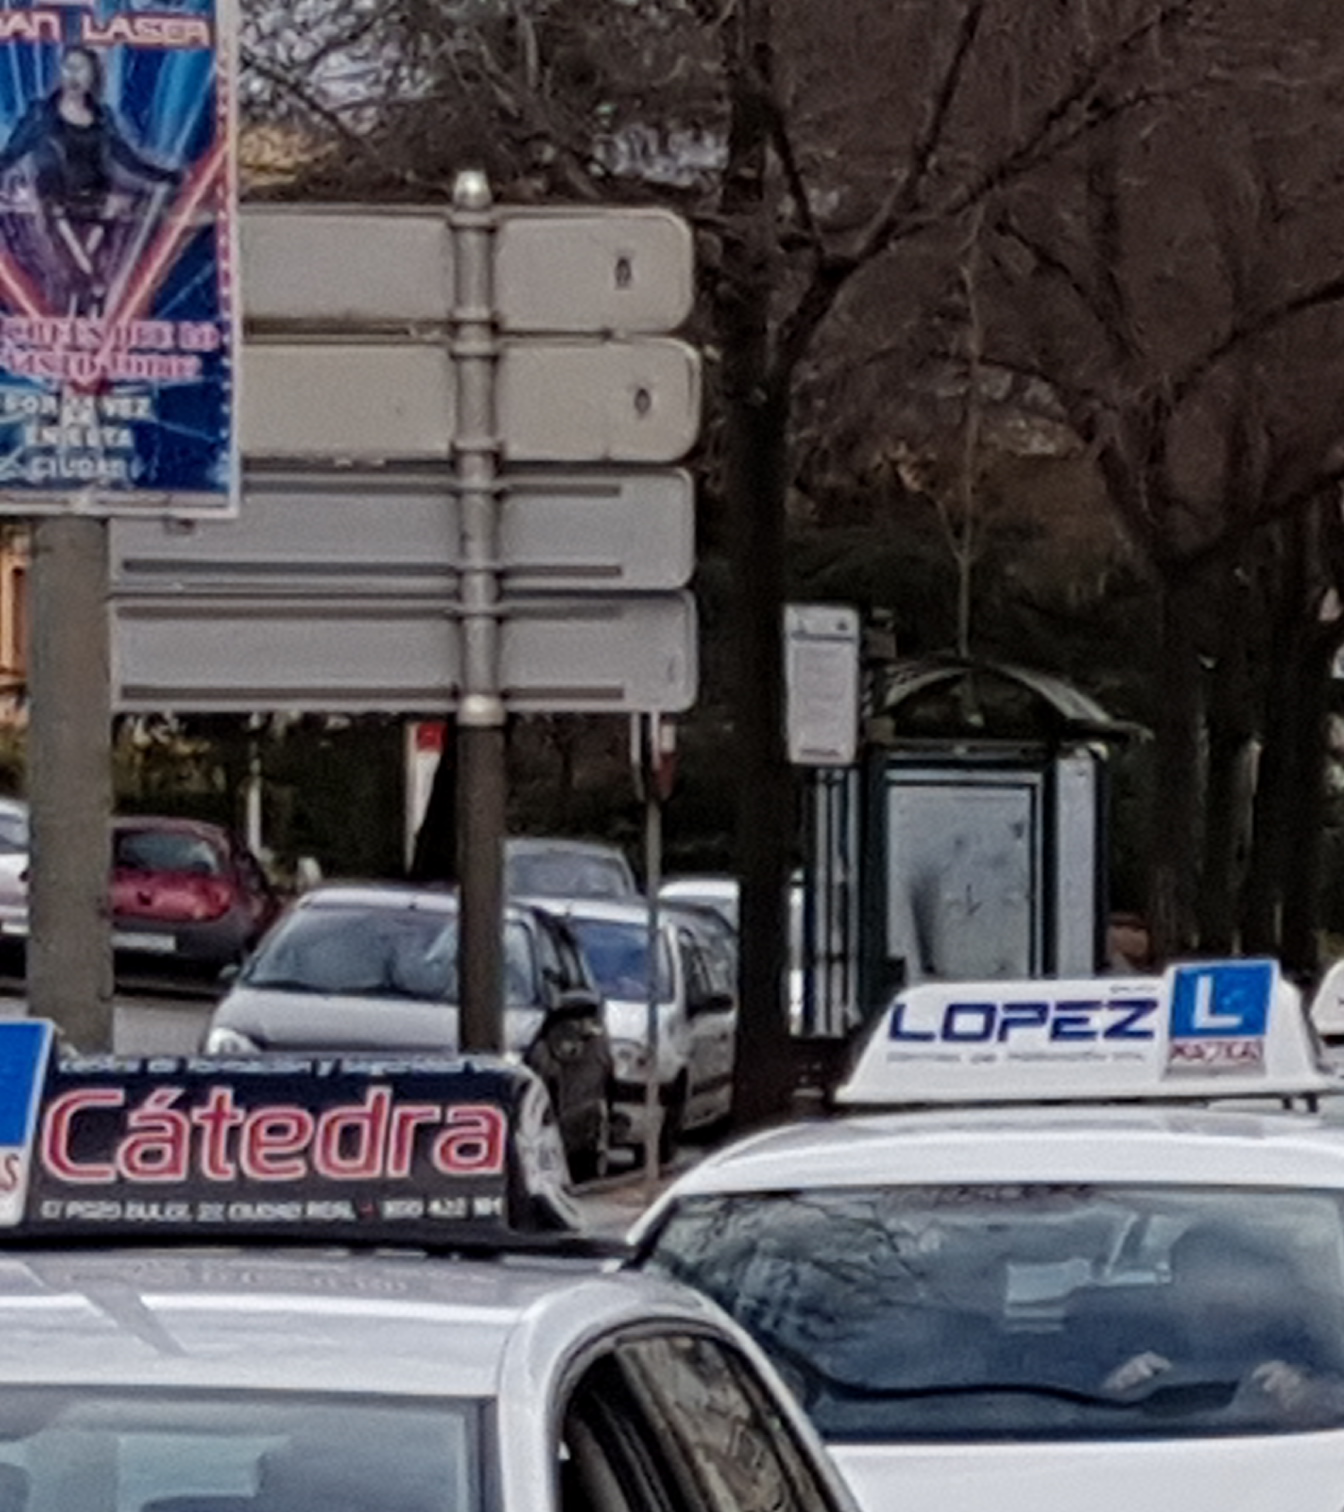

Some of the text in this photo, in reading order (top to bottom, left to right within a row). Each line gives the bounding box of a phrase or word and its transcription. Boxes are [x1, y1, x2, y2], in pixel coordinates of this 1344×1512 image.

[83, 14, 212, 47] LASER
[888, 998, 1159, 1043] LOPEZ
[1193, 976, 1242, 1029] L
[40, 1086, 507, 1183] Cátedra
